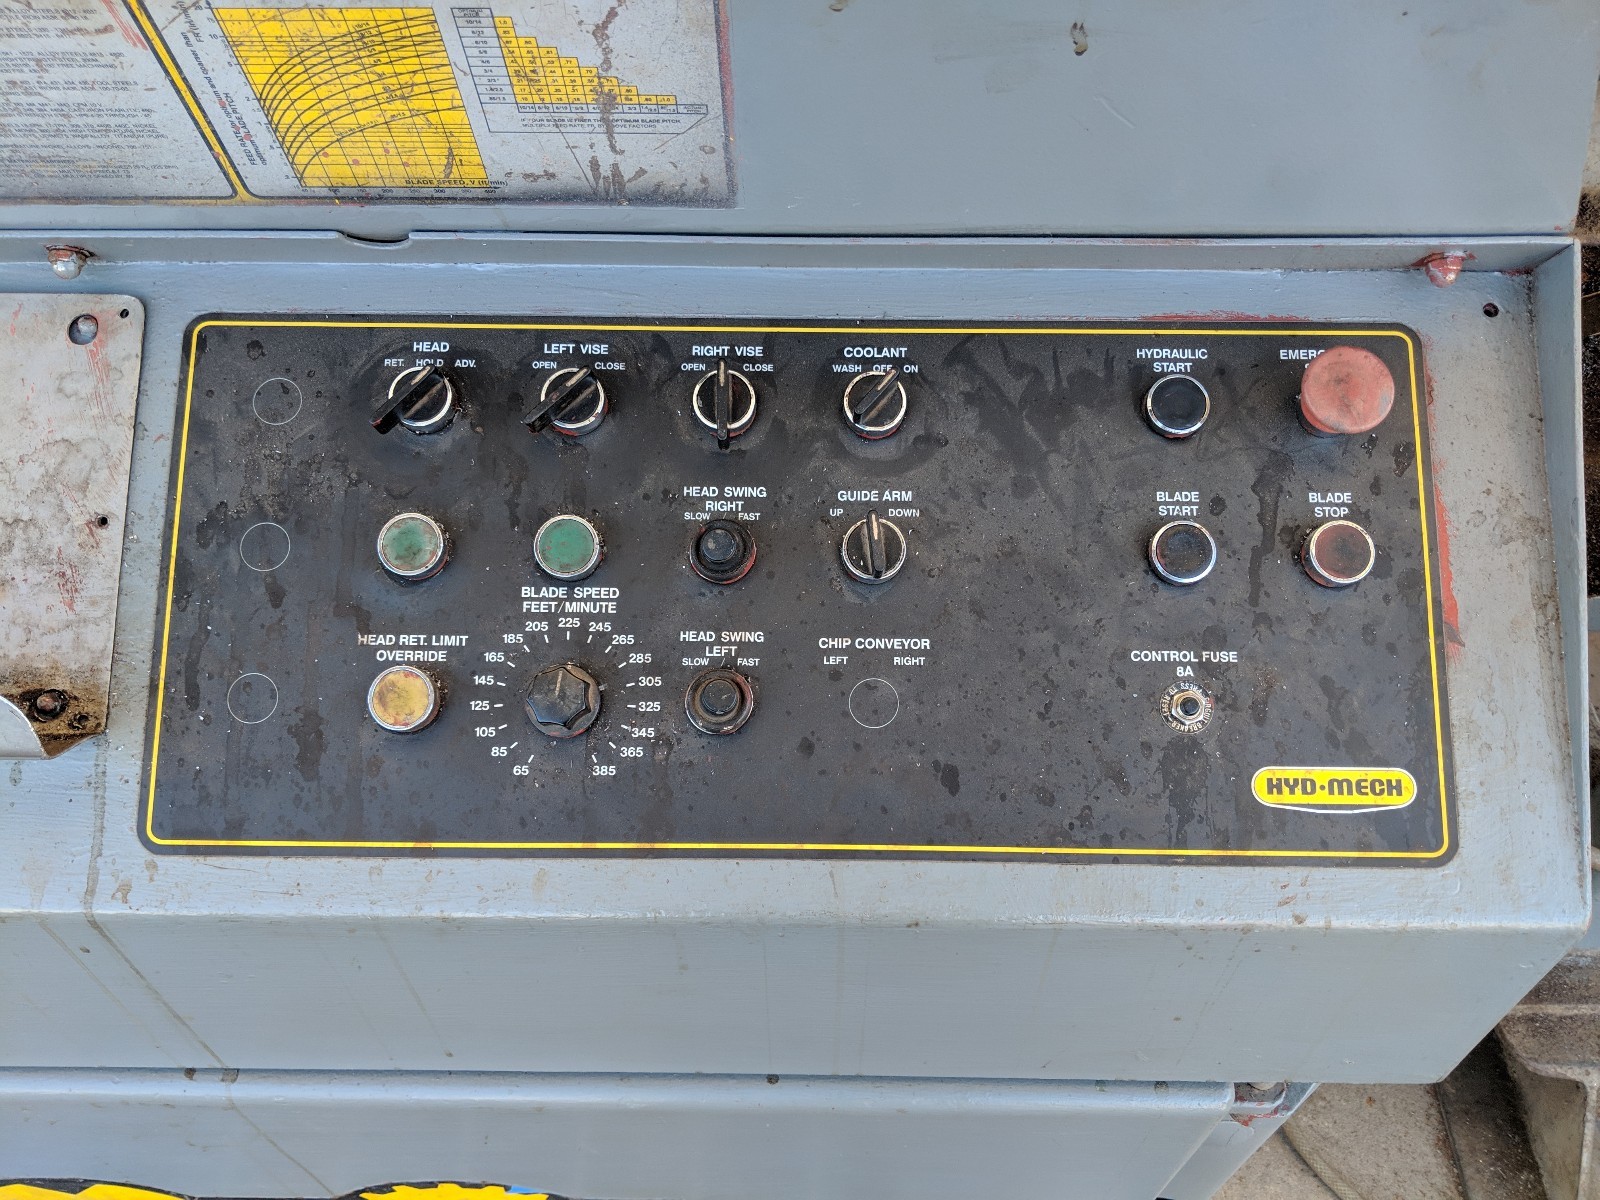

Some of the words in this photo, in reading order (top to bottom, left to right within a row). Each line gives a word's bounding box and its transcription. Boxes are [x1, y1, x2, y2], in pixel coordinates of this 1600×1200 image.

[223, 92, 241, 115] PITCH
[243, 148, 257, 166] FEED
[412, 341, 450, 353] HEAD
[543, 343, 576, 354] LEFT
[579, 343, 609, 355] VISE
[691, 345, 731, 357] RIGHT
[734, 345, 764, 357] VISE
[843, 346, 908, 358] COOLANT
[1136, 348, 1209, 360] HYDRAULIC
[383, 358, 405, 367] RET.
[415, 358, 444, 368] HOLD
[454, 359, 477, 368] ADV.
[531, 360, 558, 370] OPEN
[594, 361, 626, 371] CLOSE
[680, 362, 706, 372] OPEN
[742, 363, 774, 372] CLOSE
[831, 364, 862, 373] WASH
[903, 364, 919, 374] ON
[1152, 361, 1193, 373] START
[683, 485, 719, 498] HEAD
[723, 486, 768, 498] SWING
[836, 490, 880, 503] GUIDE
[882, 490, 913, 502] ARM
[1156, 491, 1200, 503] BLADE
[1308, 492, 1353, 504] BLADE
[705, 500, 745, 512] RIGHT
[1158, 505, 1199, 517] START
[1314, 506, 1350, 518] STOP
[684, 511, 711, 520] SLOW
[737, 512, 761, 521] FAST
[829, 507, 844, 517] UP
[887, 507, 921, 518] DOWN
[520, 585, 568, 599] BLADE
[573, 586, 620, 599] SPEED
[521, 598, 618, 614] FEET/MINUTE
[524, 618, 549, 632] 205
[557, 616, 581, 628] 225
[588, 621, 612, 633] 245
[356, 632, 398, 647] HEAD
[398, 633, 429, 647] RET.
[431, 634, 470, 648] LIMIT
[500, 631, 525, 646] 185
[611, 633, 635, 645] 265
[679, 629, 717, 643] HEAD
[720, 629, 766, 643] SWING
[817, 636, 852, 650] CHIP
[854, 638, 931, 650] CONVEYOR
[375, 648, 448, 662] OVERRIDE
[483, 650, 506, 663] 165
[705, 645, 739, 657] LEFT
[1130, 650, 1199, 663] CONTROL
[1201, 650, 1238, 663] FUSE
[628, 652, 652, 664] 285
[681, 656, 710, 667] SLOW
[736, 657, 761, 667] FAST
[823, 654, 849, 665] LEFT
[893, 656, 926, 666] RIGHT
[1175, 665, 1194, 677] 8A
[472, 673, 495, 686] 145
[637, 675, 663, 687] 305
[469, 699, 490, 711] 125
[636, 700, 662, 712] 325
[473, 726, 497, 738] 105
[631, 726, 656, 738] 345
[490, 745, 508, 758] 85
[619, 746, 644, 758] 365
[512, 764, 531, 777] 65
[591, 764, 617, 777] 385
